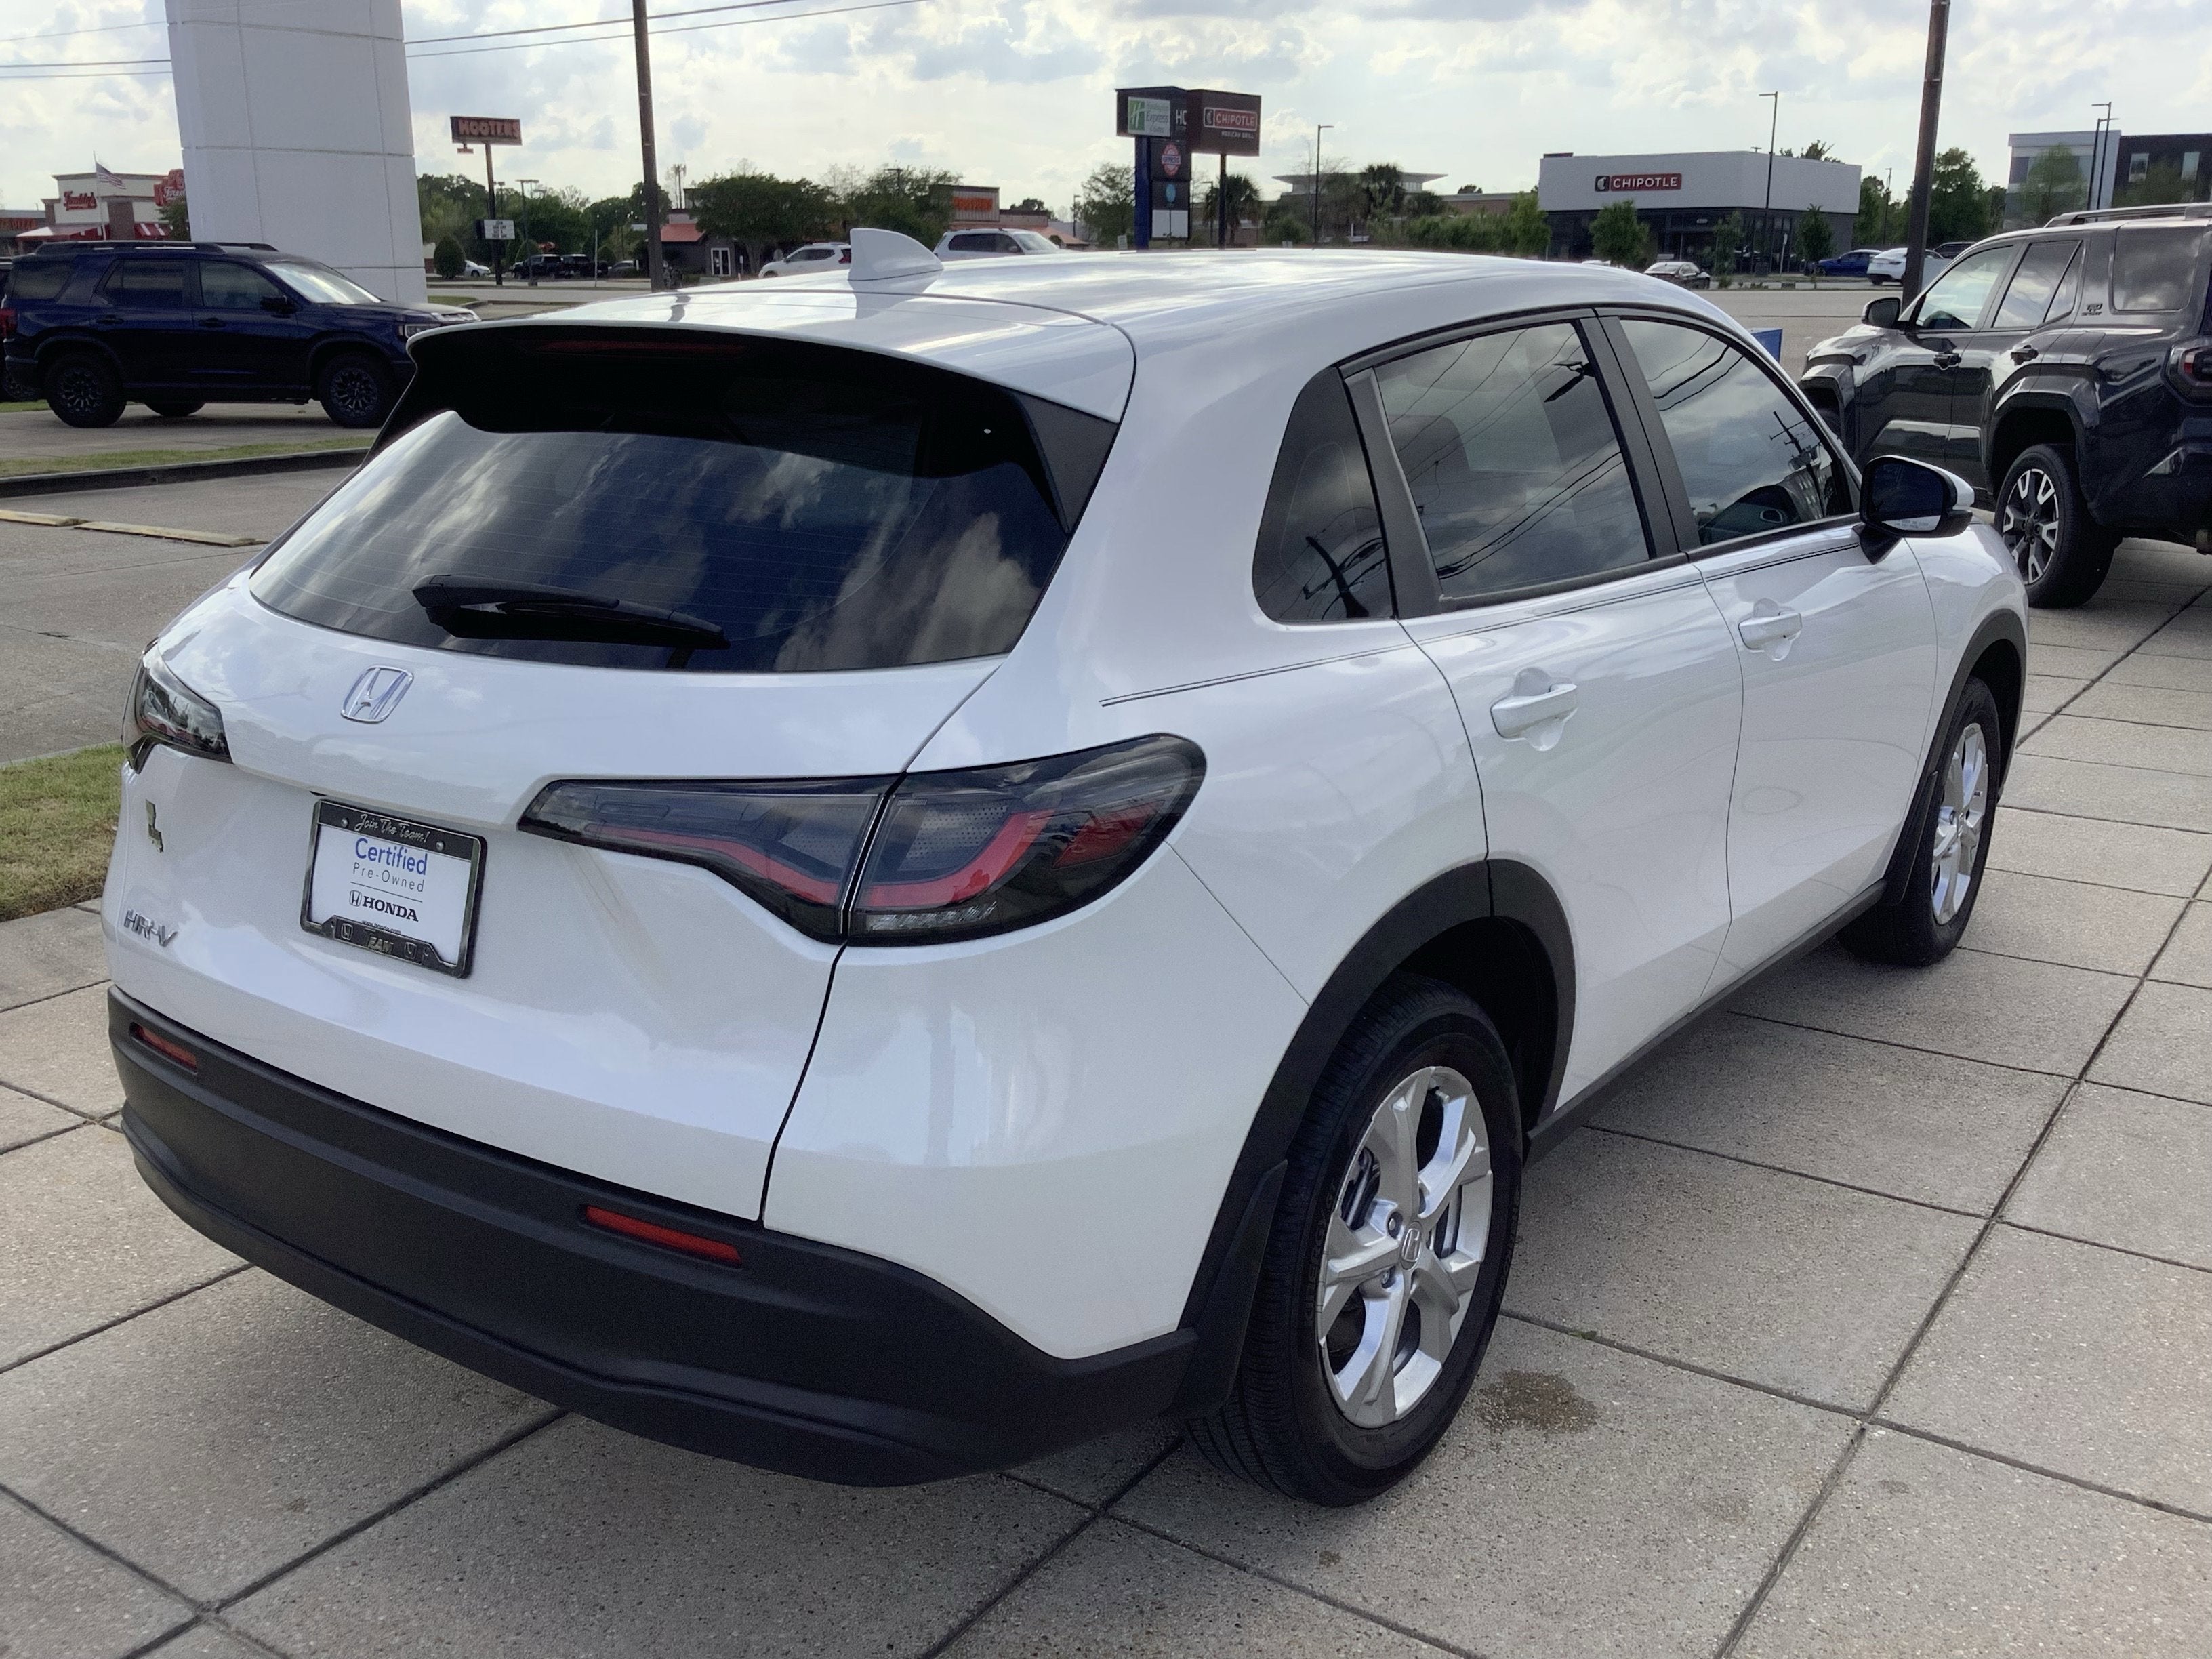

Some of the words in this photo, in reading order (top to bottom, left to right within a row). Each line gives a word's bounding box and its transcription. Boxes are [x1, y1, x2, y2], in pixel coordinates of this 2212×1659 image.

[1216, 112, 1254, 127] CHIPOTLE
[1613, 176, 1678, 188] CHIPOTLE
[354, 813, 379, 832] Join
[380, 817, 397, 835] The
[398, 822, 430, 843] Team!
[355, 837, 428, 876] Certified
[353, 861, 424, 893] Pre-Owned
[362, 895, 419, 922] HONDA
[123, 908, 178, 947] HR-V
